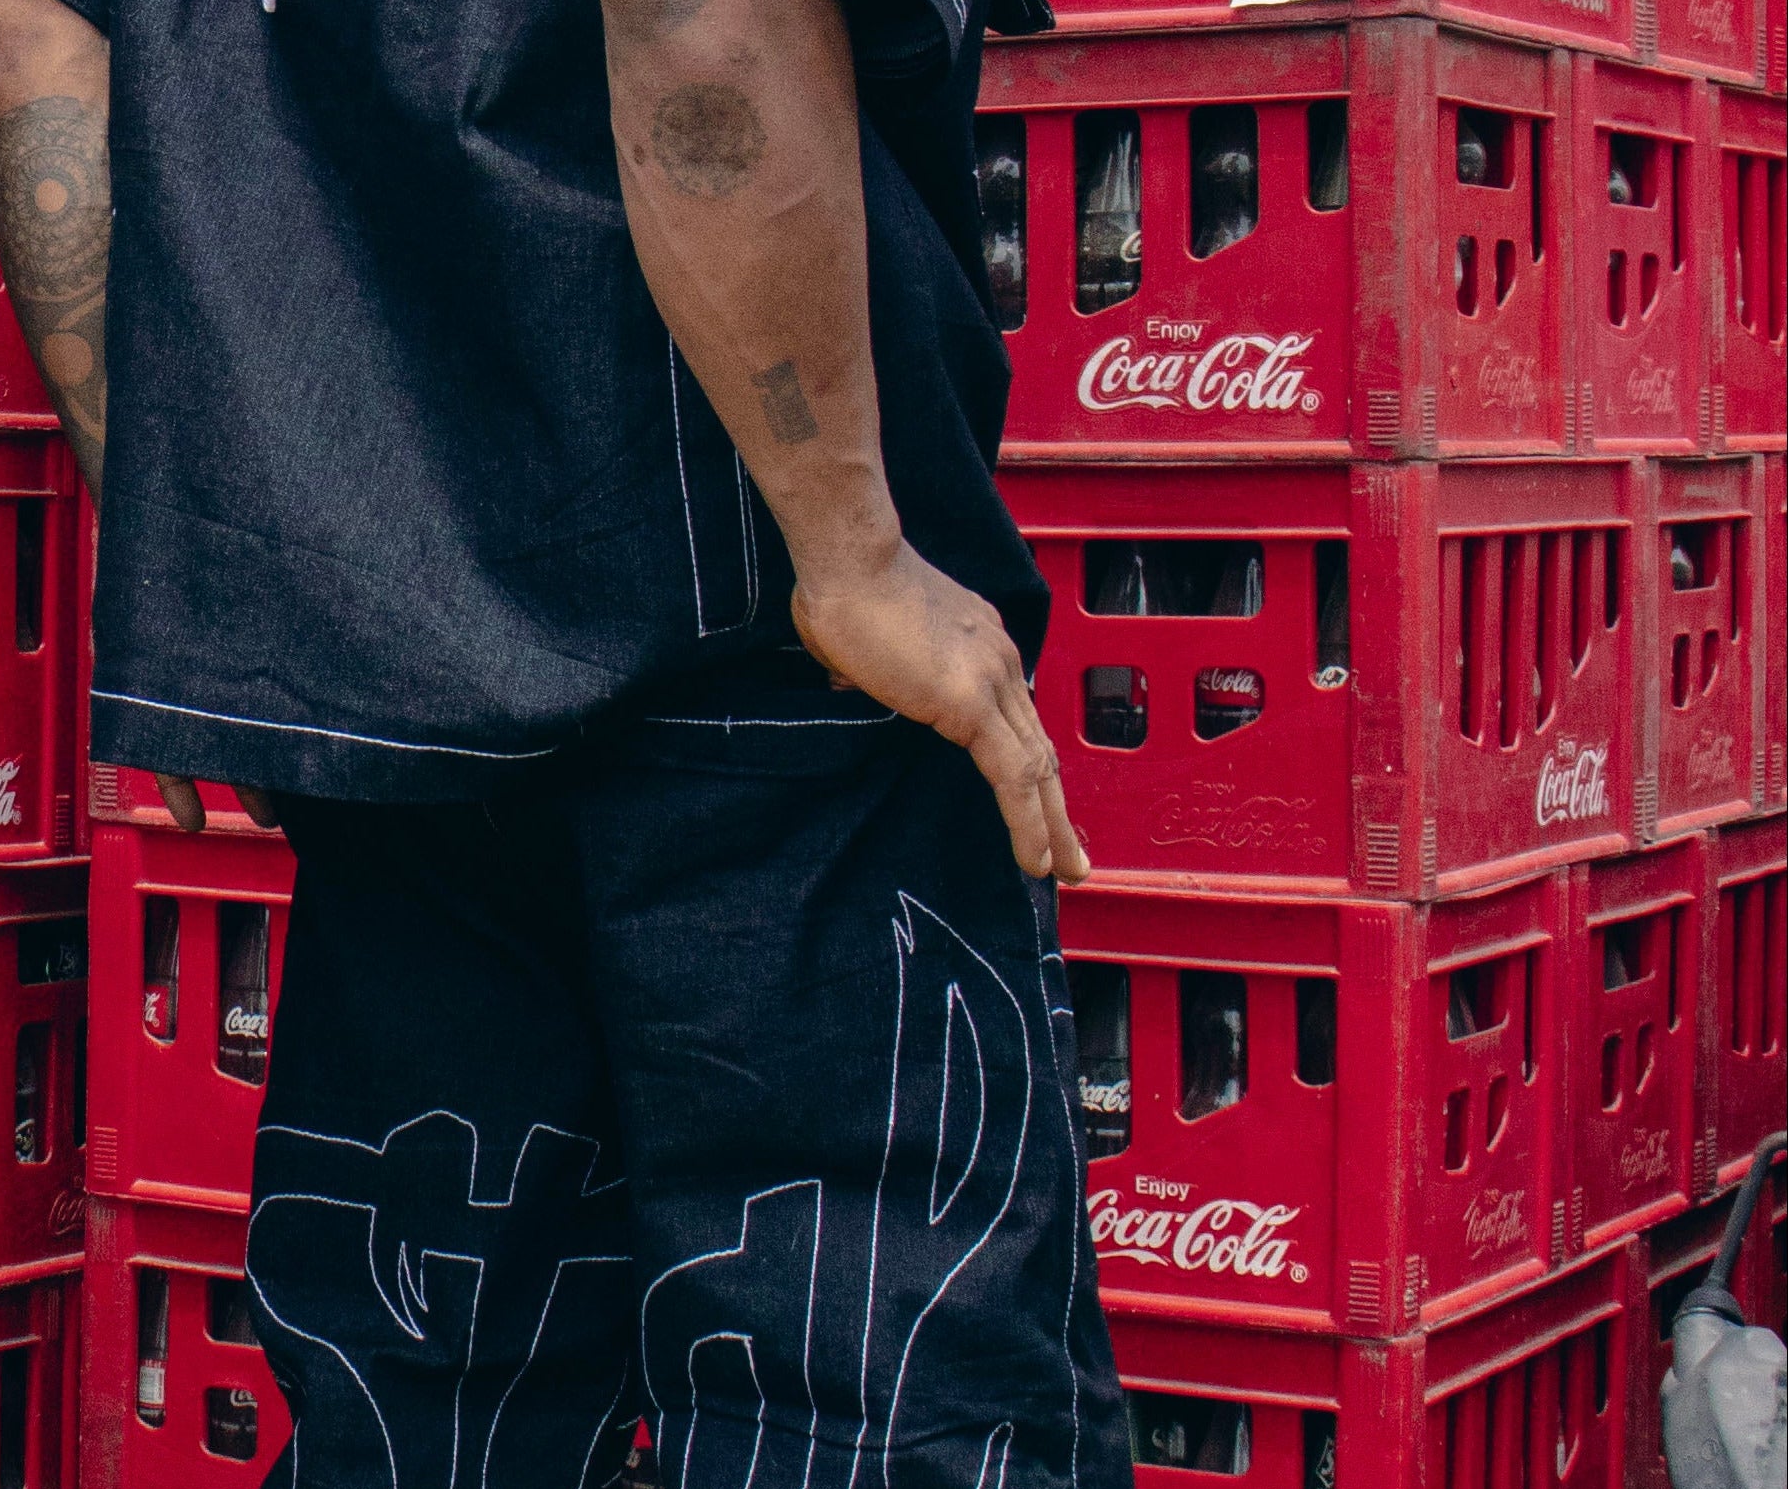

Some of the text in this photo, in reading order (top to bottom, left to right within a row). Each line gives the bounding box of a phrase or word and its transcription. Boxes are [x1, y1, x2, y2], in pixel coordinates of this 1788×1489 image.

[1147, 321, 1202, 344] Enjoy
[1078, 337, 1313, 409] Coca-Cola
[1538, 750, 1608, 826] Coca-Cola
[1136, 1175, 1187, 1199] Enjoy
